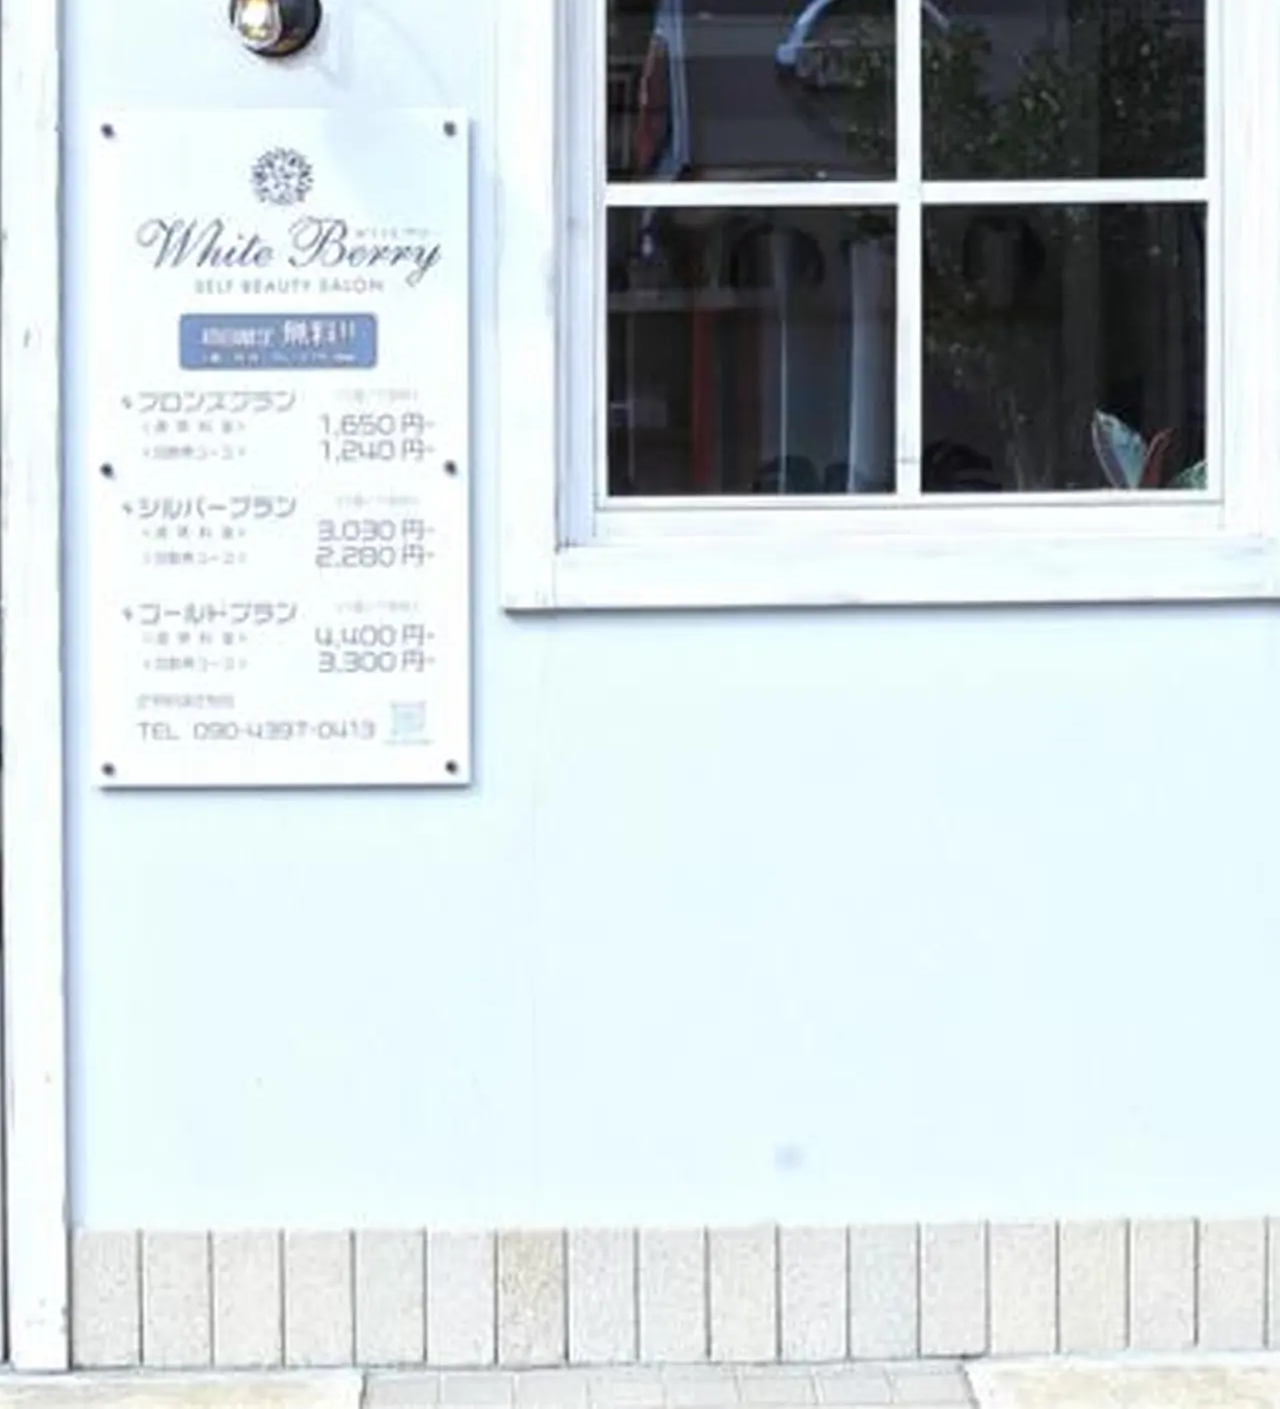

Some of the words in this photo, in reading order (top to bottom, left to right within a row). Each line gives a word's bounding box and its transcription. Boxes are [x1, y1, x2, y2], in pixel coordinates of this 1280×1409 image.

[135, 215, 277, 270] White
[287, 214, 442, 289] Berry
[241, 277, 311, 295] BEAUTY
[318, 277, 386, 295] SALON
[136, 720, 181, 742] TEL
